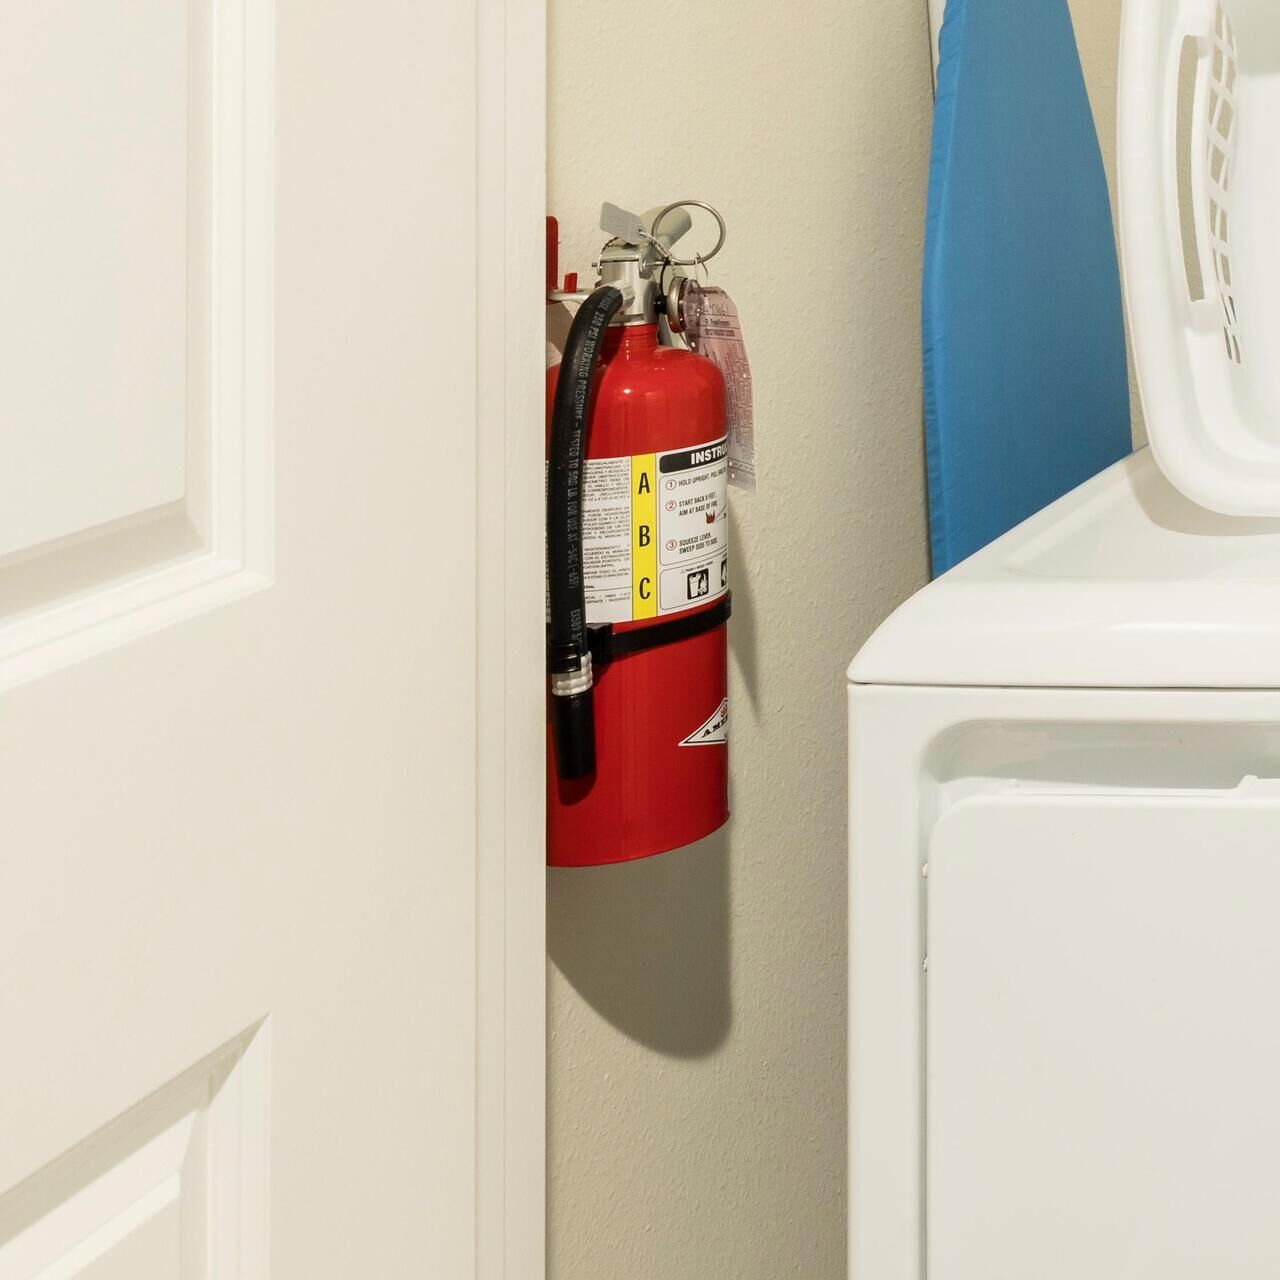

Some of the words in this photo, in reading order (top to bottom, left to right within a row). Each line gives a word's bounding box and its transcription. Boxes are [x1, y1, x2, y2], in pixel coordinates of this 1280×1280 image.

[592, 312, 605, 326] 250
[587, 326, 599, 339] PSI
[578, 340, 595, 377] WORKING
[569, 458, 579, 468] TO
[638, 472, 650, 494] A
[679, 478, 691, 487] HOLD
[568, 501, 578, 517] FOR
[679, 498, 693, 507] START
[679, 508, 688, 516] AIM
[695, 504, 705, 512] BASE
[639, 525, 650, 547] B
[679, 535, 699, 547] SQUEEZE
[680, 546, 695, 554] SWEEP
[639, 577, 651, 599] C
